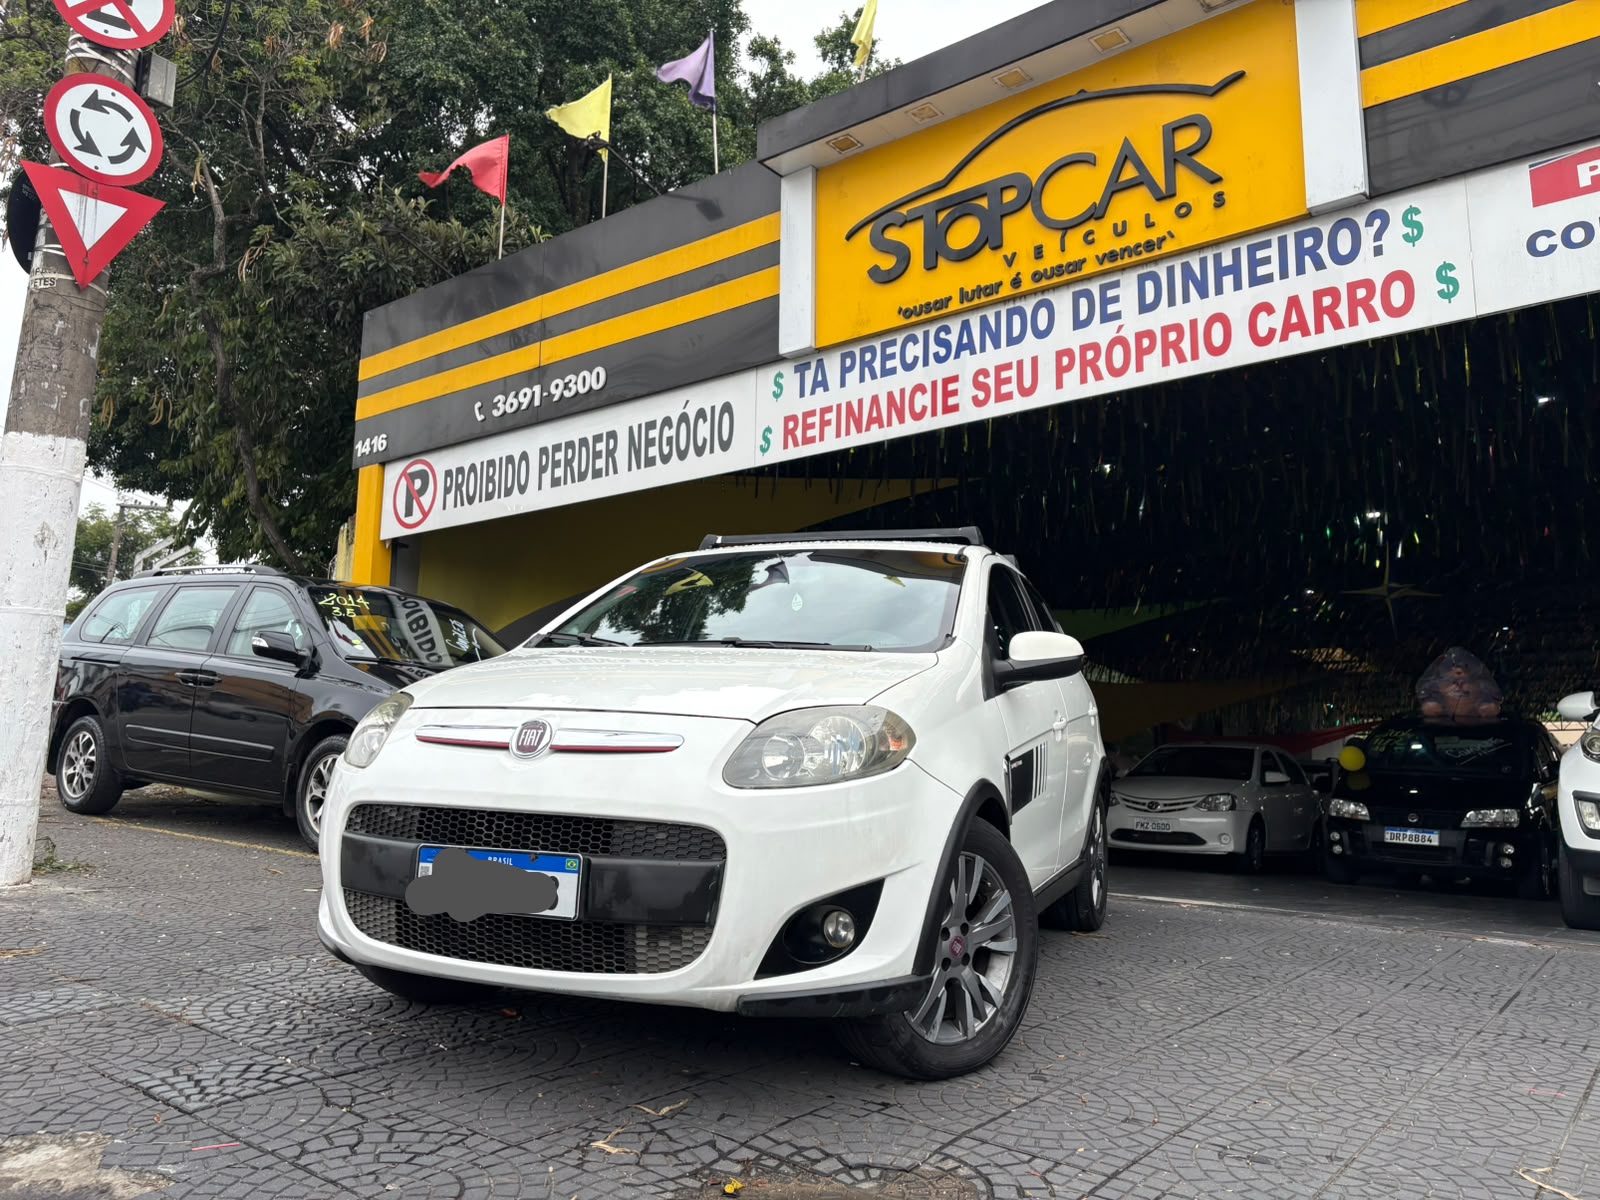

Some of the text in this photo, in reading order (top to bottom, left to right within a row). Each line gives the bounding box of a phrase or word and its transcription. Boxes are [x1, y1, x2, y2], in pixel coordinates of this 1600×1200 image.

[867, 113, 1224, 284] STOPCAR
[1003, 190, 1225, 268] VEÍCULOS
[1526, 217, 1600, 258] CO
[772, 205, 1424, 402] $ TA PRECISANDO DE DINHEIRO? $
[959, 279, 1003, 304] lutar
[1010, 272, 1022, 289] é
[1031, 256, 1087, 283] ousar
[759, 261, 1460, 456] $ REFINANCIE SEU PRÓPRIO CARRO $
[492, 366, 607, 418] 3691-9300
[355, 433, 388, 458] 1416
[442, 450, 530, 511] PROIBIDO
[537, 428, 619, 491] PERDER
[627, 400, 734, 473] NEGÓCIO
[318, 592, 370, 610] 2014
[332, 606, 356, 618] 3.5
[518, 728, 544, 746] FIAT
